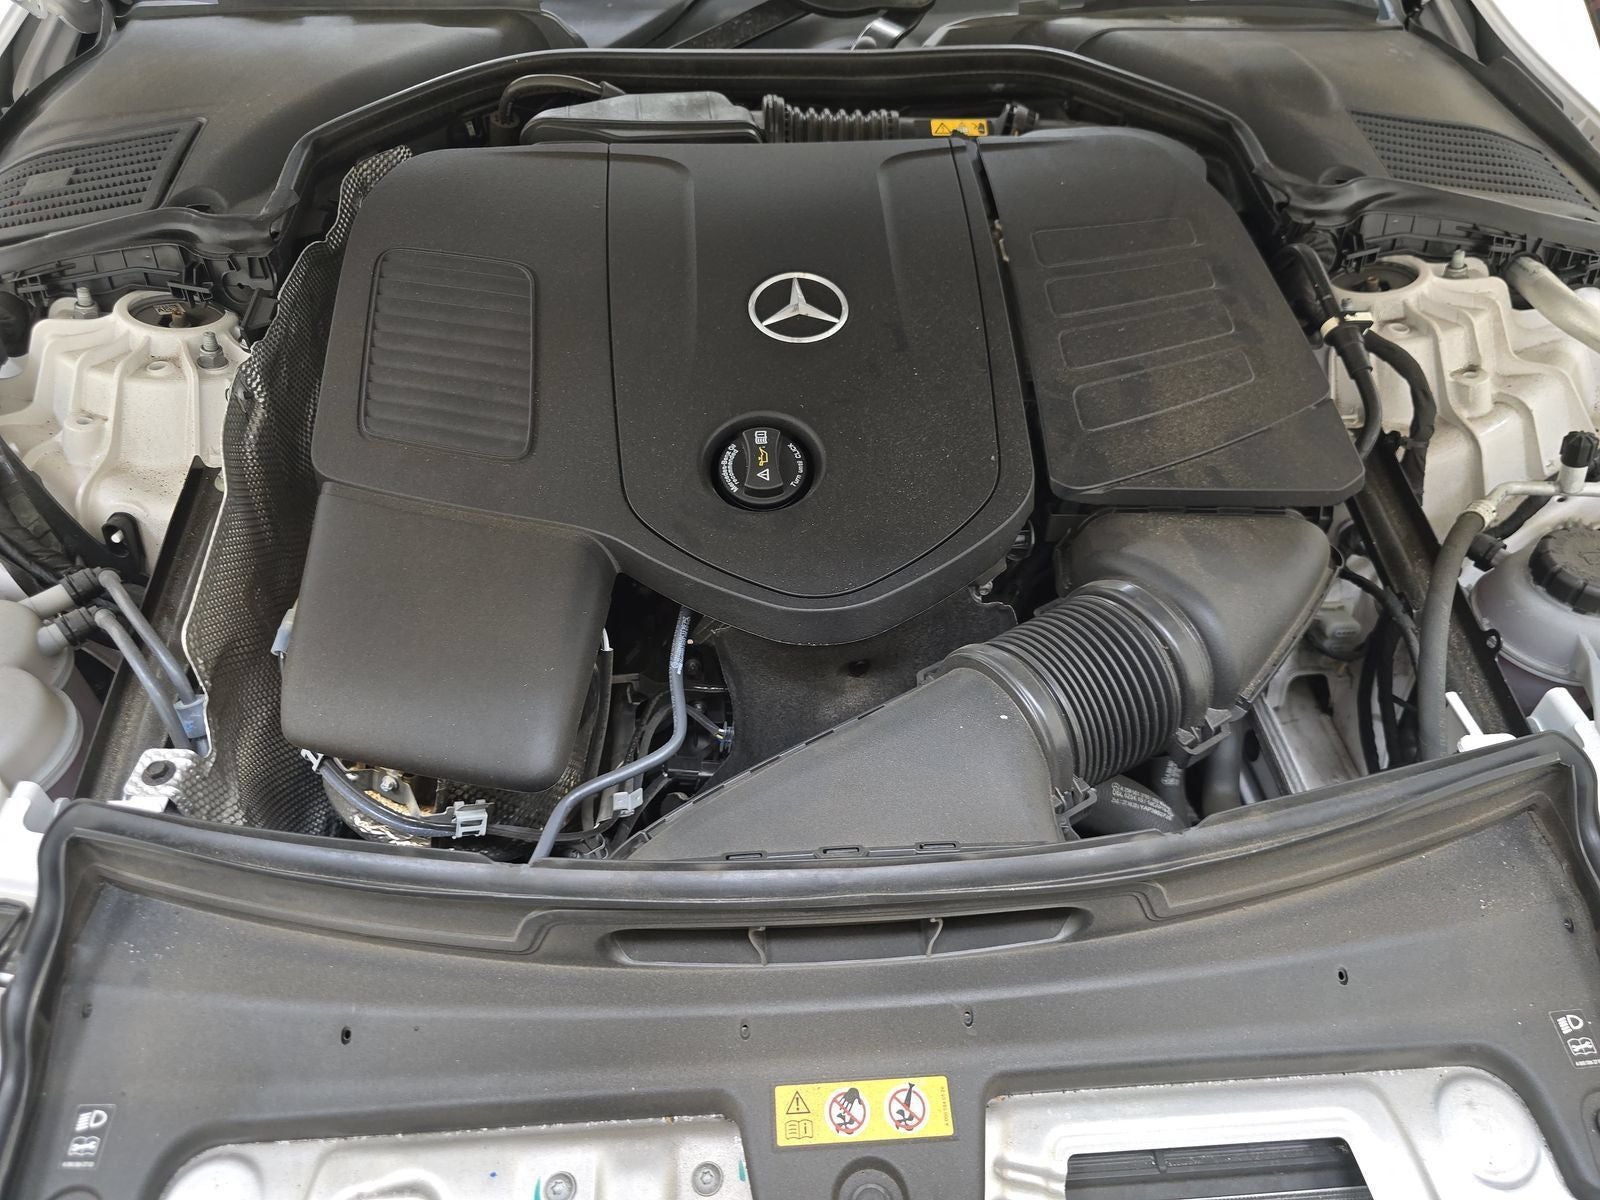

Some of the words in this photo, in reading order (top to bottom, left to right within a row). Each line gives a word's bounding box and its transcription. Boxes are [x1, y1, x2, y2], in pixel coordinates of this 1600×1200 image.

[787, 443, 801, 459] CLICK
[721, 451, 739, 492] Mercedes-Benz
[728, 449, 739, 485] recommended
[790, 475, 802, 487] Turn
